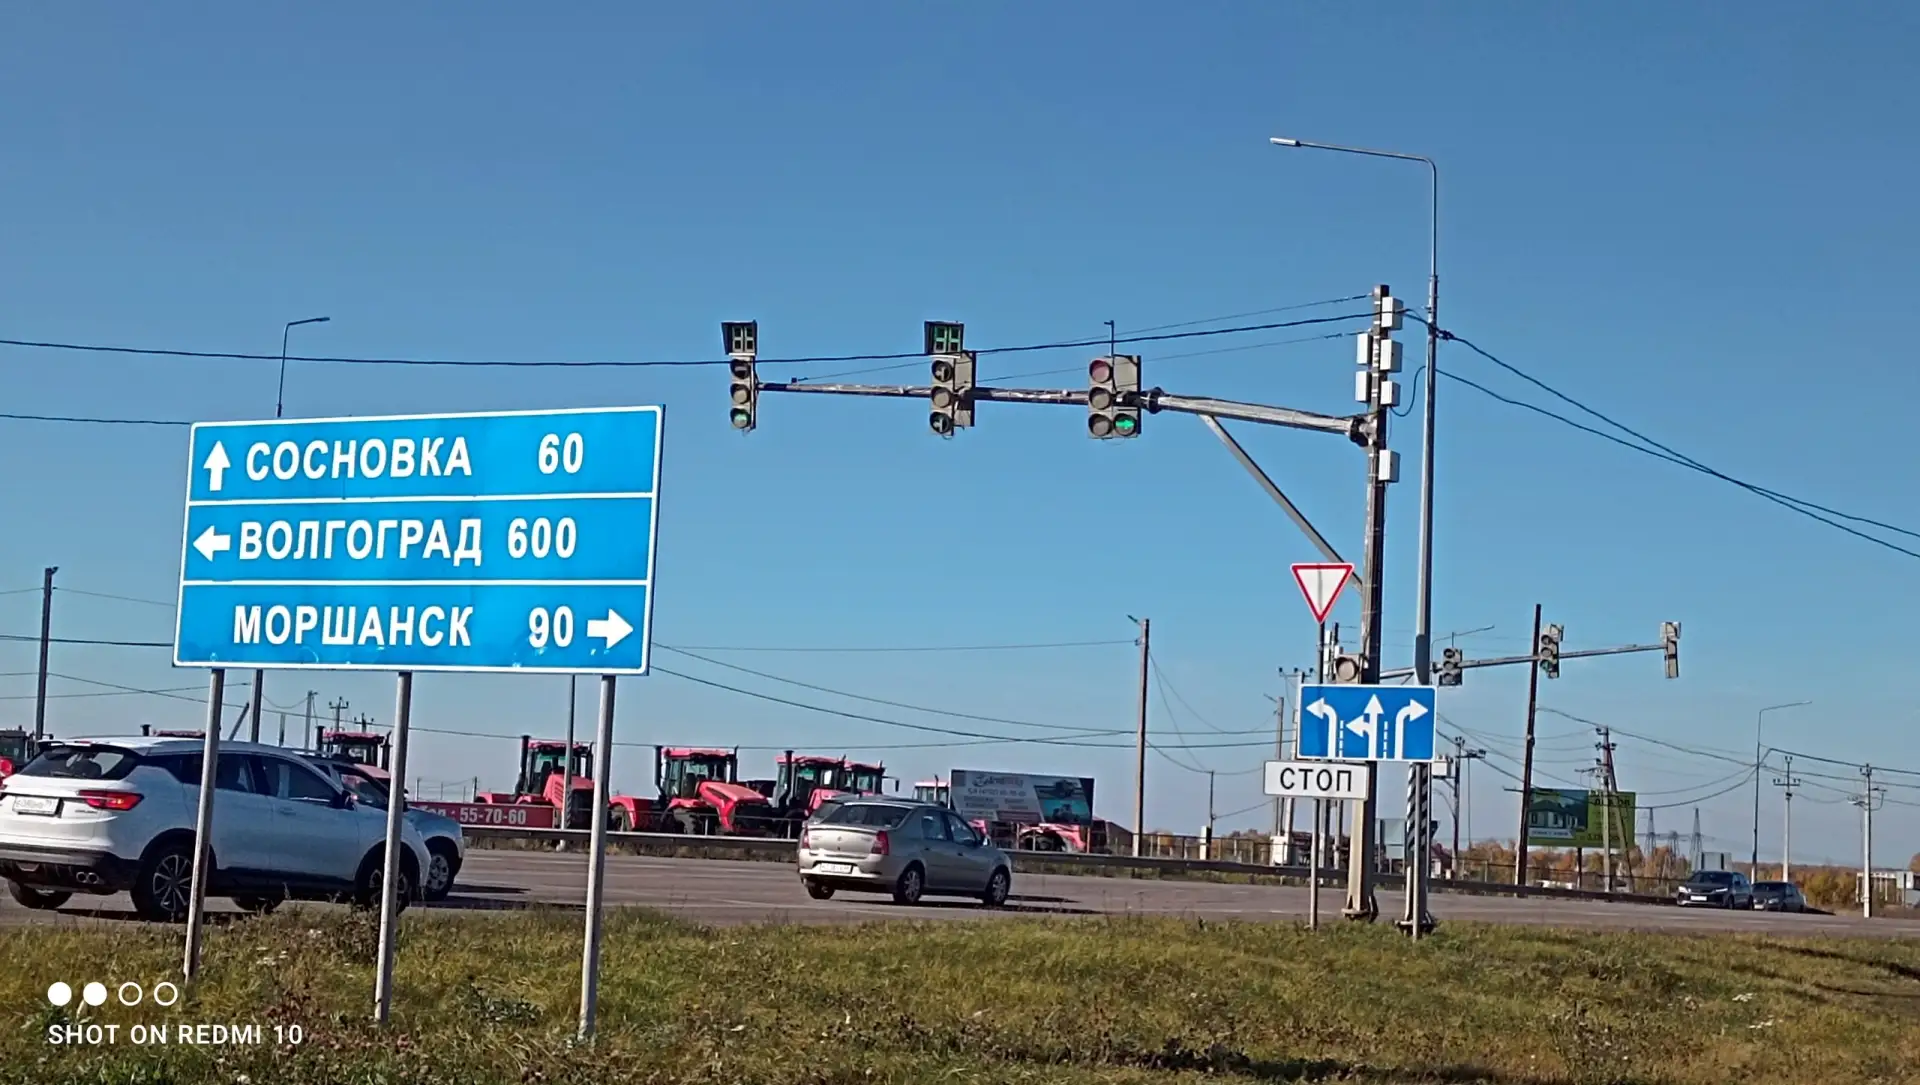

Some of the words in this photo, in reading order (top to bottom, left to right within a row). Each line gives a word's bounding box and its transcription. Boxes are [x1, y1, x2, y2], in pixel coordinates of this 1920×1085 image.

[246, 436, 472, 481] СОСНОВКА
[537, 433, 584, 474] 60
[239, 518, 482, 567] ВОЛГОГРАД
[507, 517, 577, 559] 600
[233, 605, 473, 647] МОРШАНСК
[529, 606, 574, 648] 90
[1279, 767, 1352, 792] СТОП
[460, 807, 526, 825] 55-70-60
